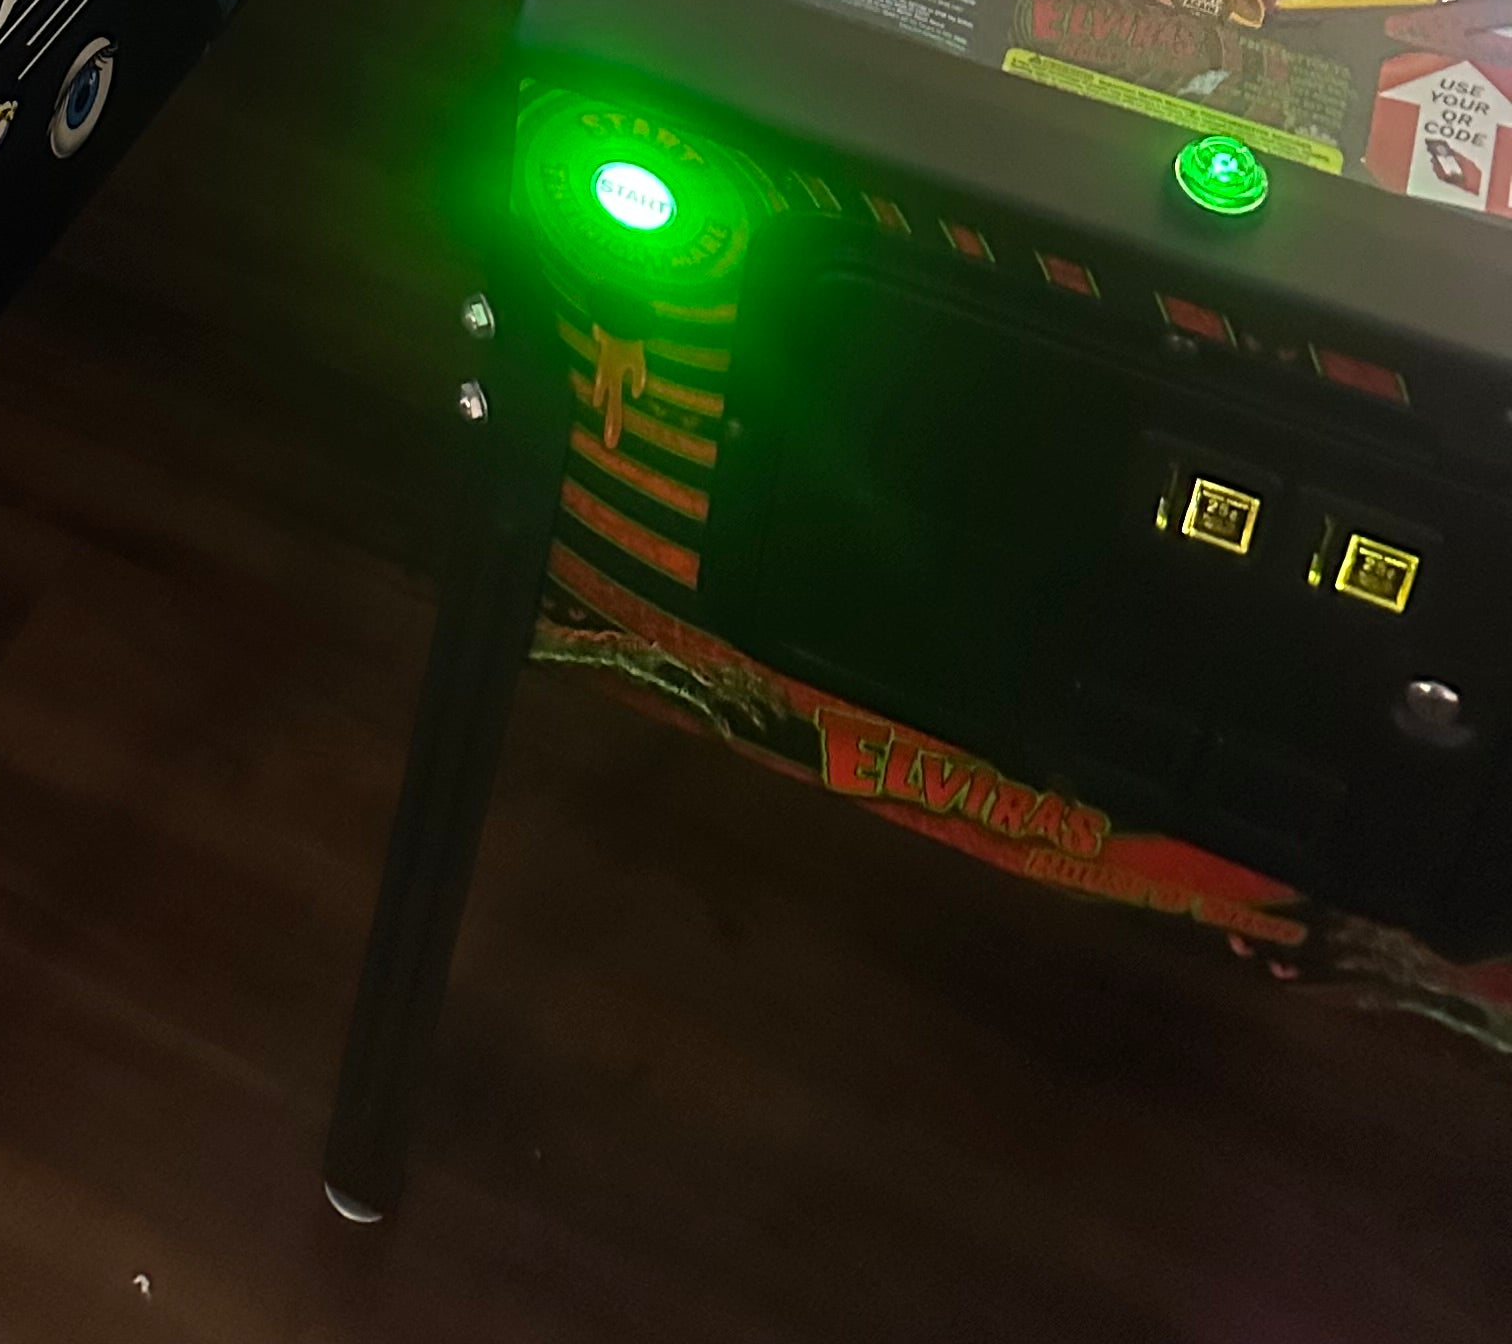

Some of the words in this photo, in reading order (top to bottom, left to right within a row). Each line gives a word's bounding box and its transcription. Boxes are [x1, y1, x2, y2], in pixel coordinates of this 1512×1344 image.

[1440, 77, 1485, 97] USE
[1431, 90, 1490, 116] YOUR
[1442, 110, 1473, 127] QR
[1424, 120, 1487, 147] CODE
[600, 178, 671, 215] START
